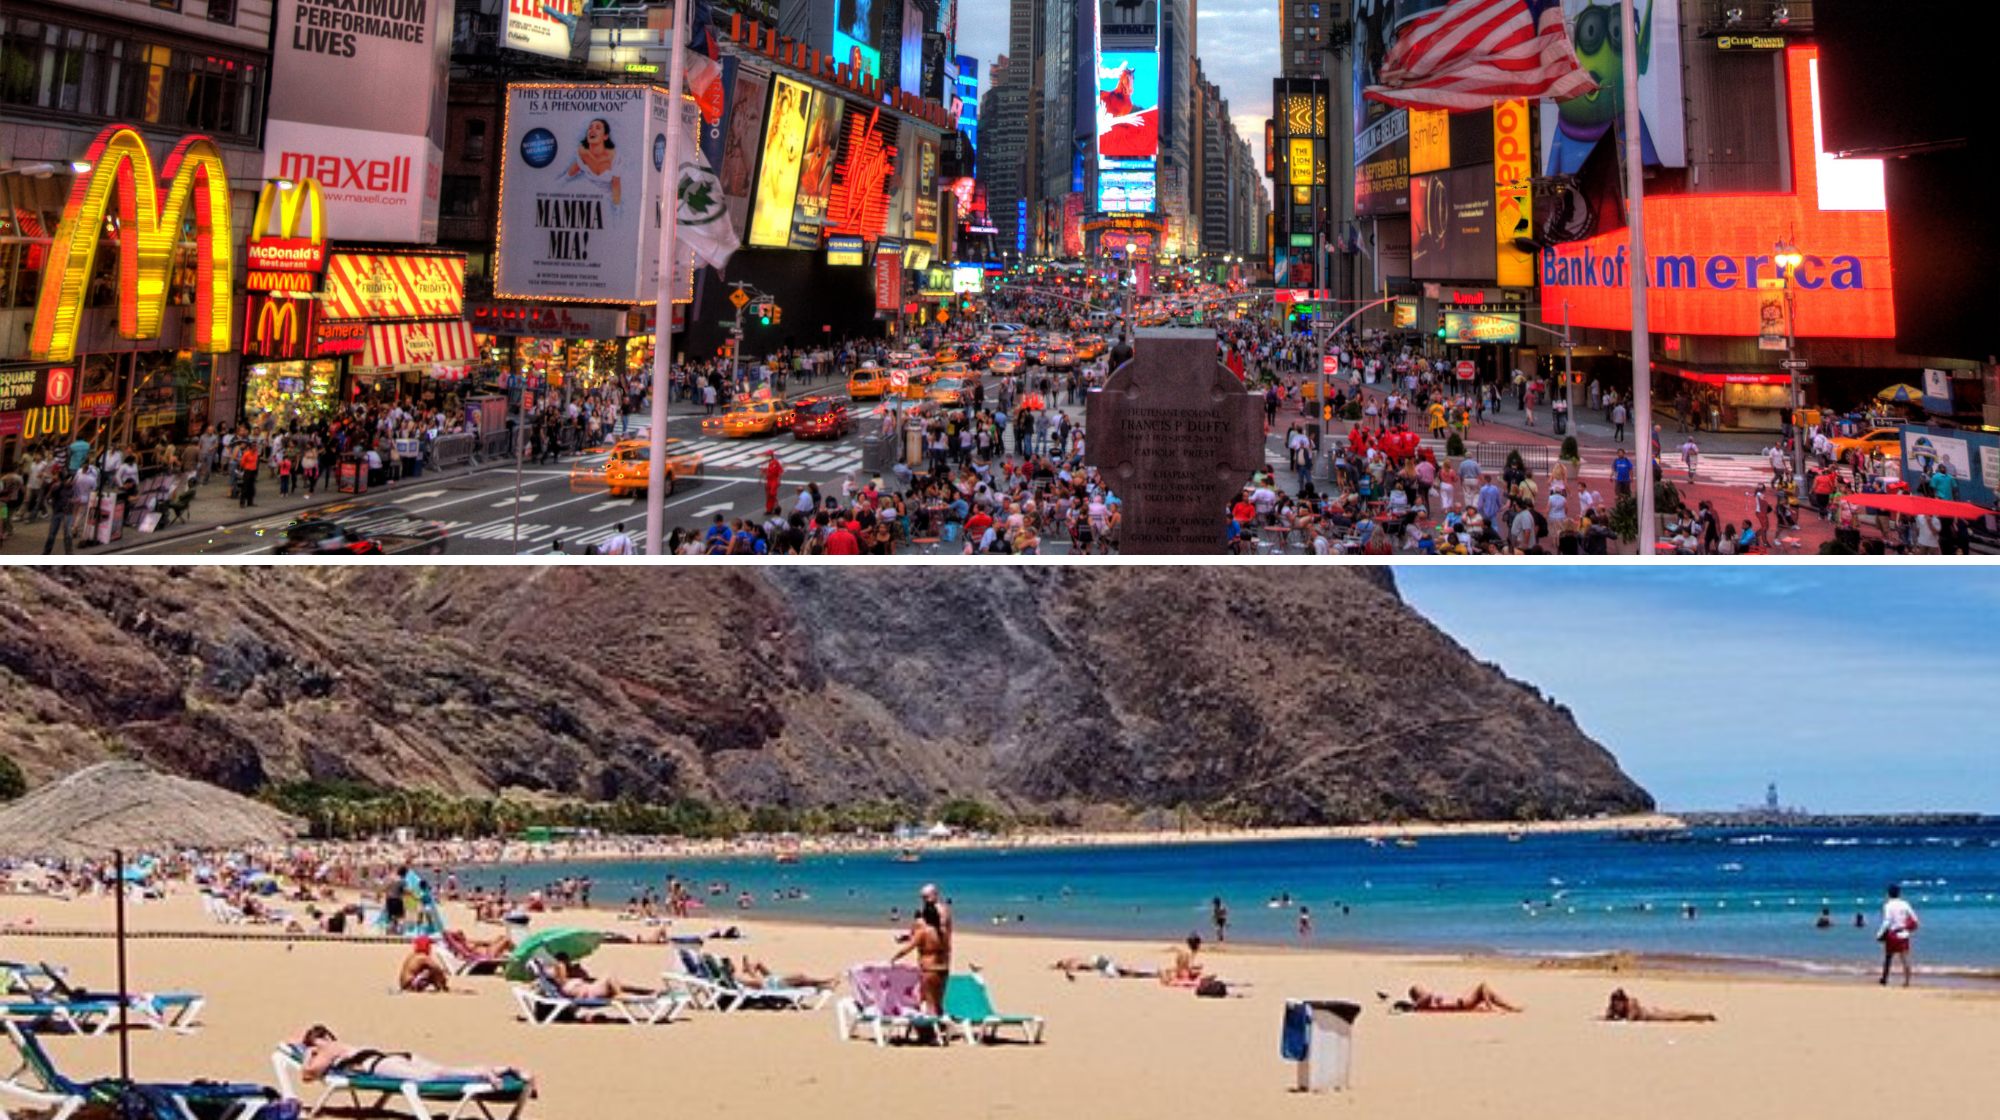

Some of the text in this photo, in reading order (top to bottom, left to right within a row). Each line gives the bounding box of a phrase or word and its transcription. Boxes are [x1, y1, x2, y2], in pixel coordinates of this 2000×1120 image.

[295, 4, 424, 43] PERFORMANCE
[1103, 26, 1155, 35] CHEVROLET
[293, 25, 356, 58] LIVES
[542, 89, 597, 100] FEEL-GOOD
[600, 90, 644, 100] MUSICAL
[529, 101, 538, 111] IS
[541, 101, 548, 111] A
[1295, 147, 1307, 155] THE
[1293, 156, 1310, 167] LION
[280, 151, 411, 194] maxell
[1293, 167, 1311, 179] KING
[1366, 158, 1398, 180] SEPTEMBER
[1399, 156, 1408, 176] 19
[535, 199, 604, 230] MAMMA
[547, 230, 590, 261] MIA!
[260, 259, 307, 269] Restaurant
[1543, 245, 1599, 287] Bank
[1602, 244, 1625, 287] of
[475, 306, 573, 322] DIGITAL
[1445, 304, 1520, 312] MARQUIS
[1469, 315, 1501, 326] WHITE
[1459, 323, 1516, 340] CHRISTMAS
[0, 370, 36, 385] SQUARE
[1121, 419, 1172, 431] FRANCIS
[1188, 421, 1231, 434] DUFFY
[1183, 450, 1215, 458] PRIEST
[1179, 518, 1215, 526] SERVICE
[1177, 535, 1218, 544] COUNTRY
